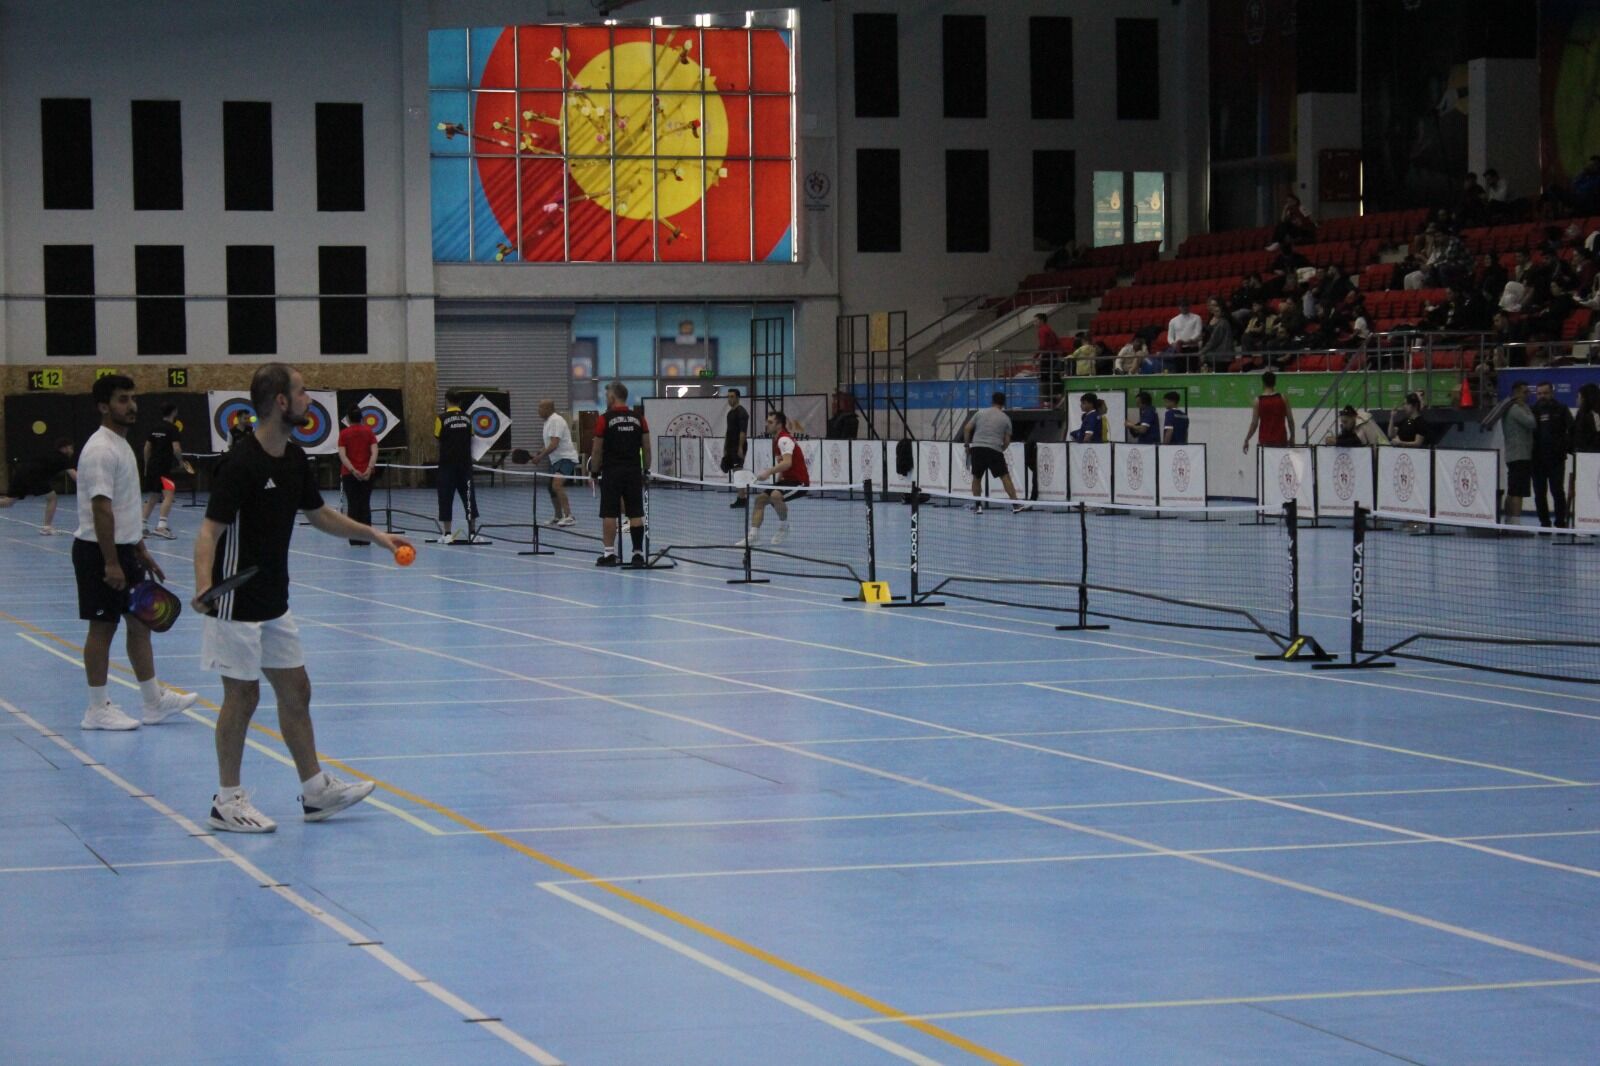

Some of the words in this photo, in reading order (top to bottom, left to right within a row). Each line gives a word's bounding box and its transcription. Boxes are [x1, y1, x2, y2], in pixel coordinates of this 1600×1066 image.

[46, 371, 60, 385] 12
[170, 371, 185, 385] 15
[1353, 542, 1364, 605] JOOLA
[871, 584, 881, 600] 7
